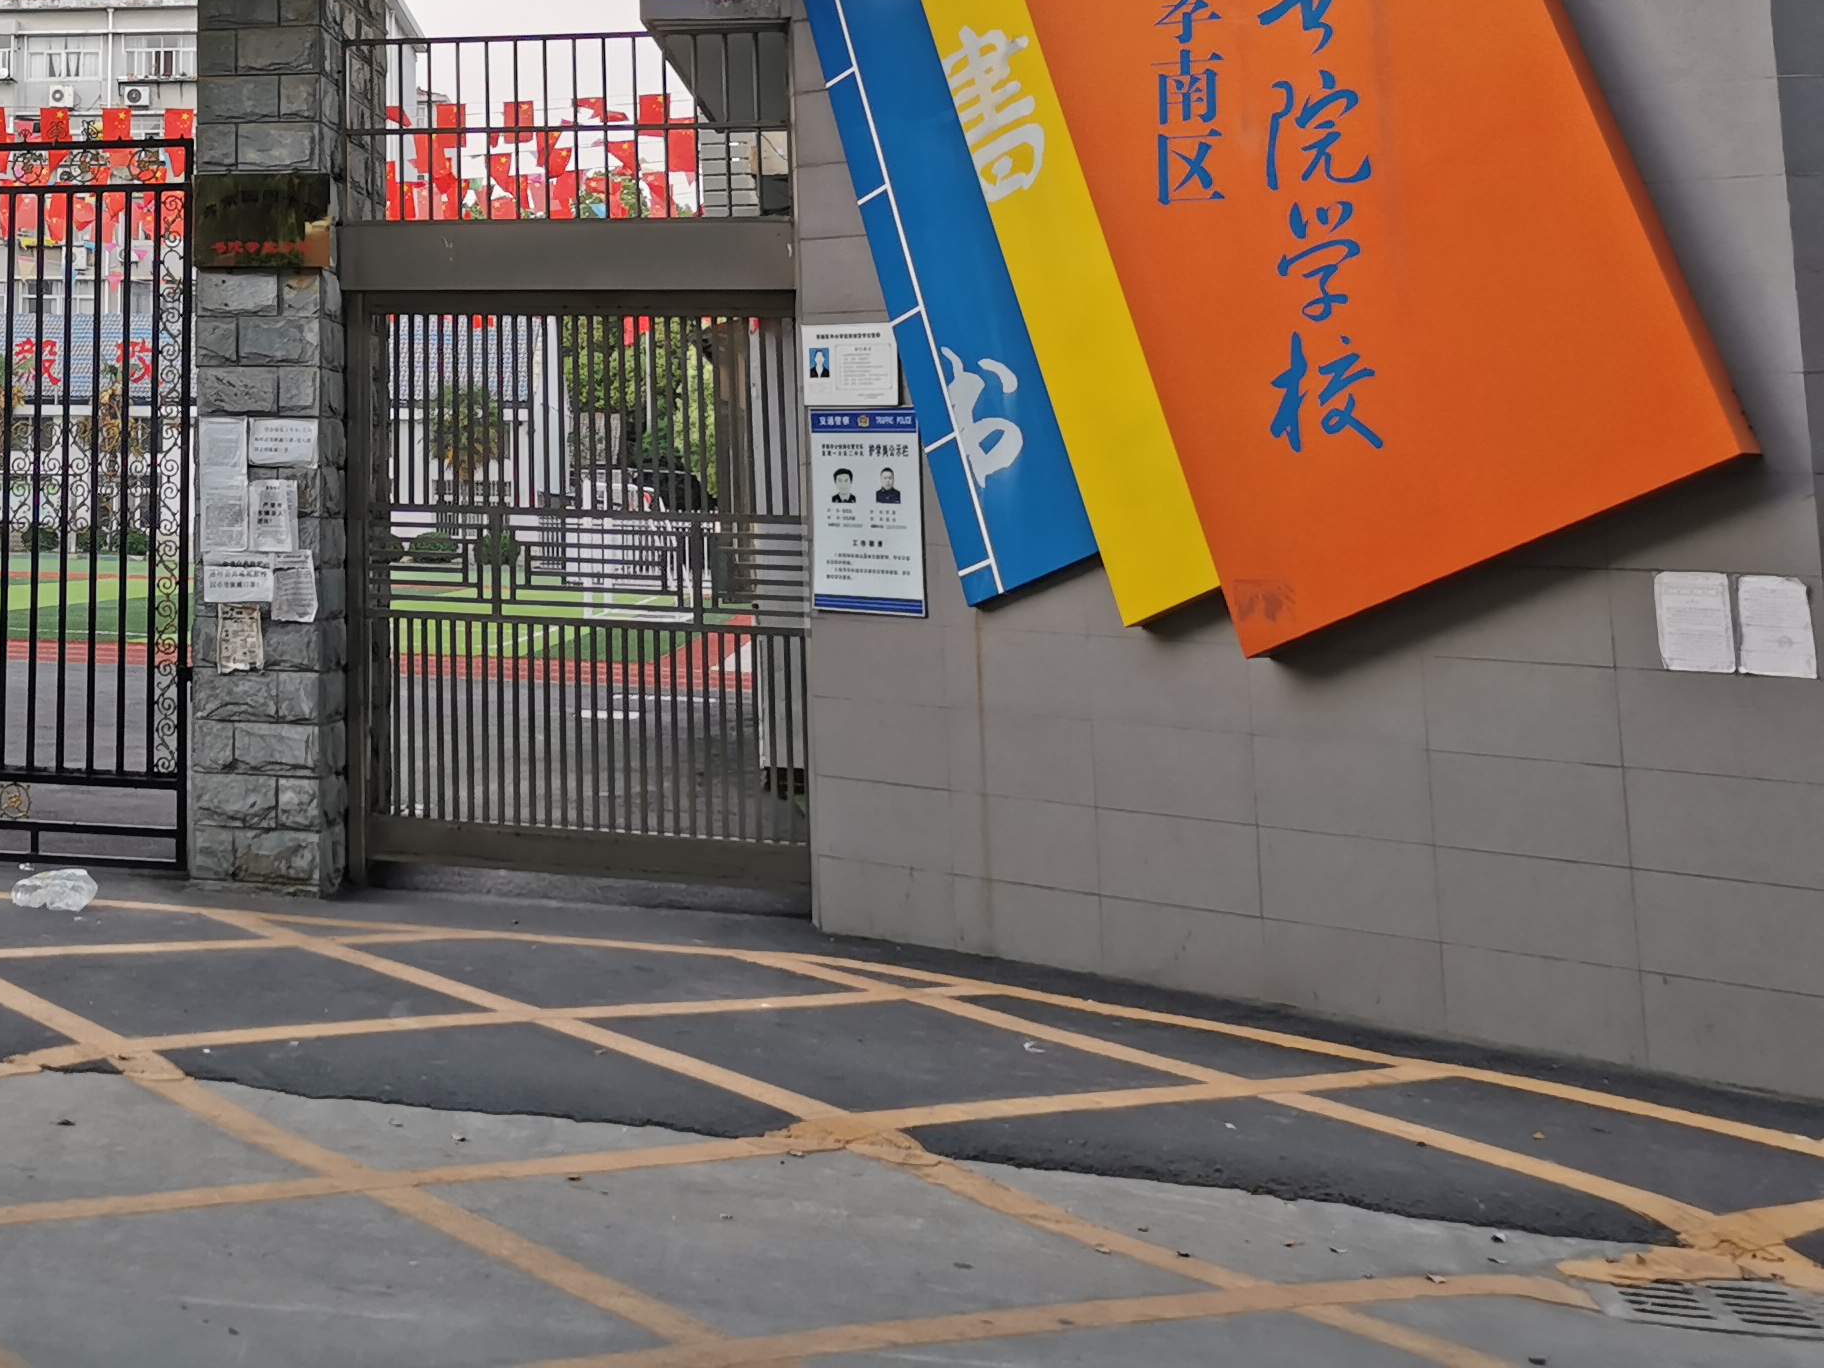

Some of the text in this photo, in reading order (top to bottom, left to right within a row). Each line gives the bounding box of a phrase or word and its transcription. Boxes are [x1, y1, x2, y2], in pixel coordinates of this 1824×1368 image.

[818, 416, 850, 426] 交通警察
[896, 416, 912, 425] POLICE
